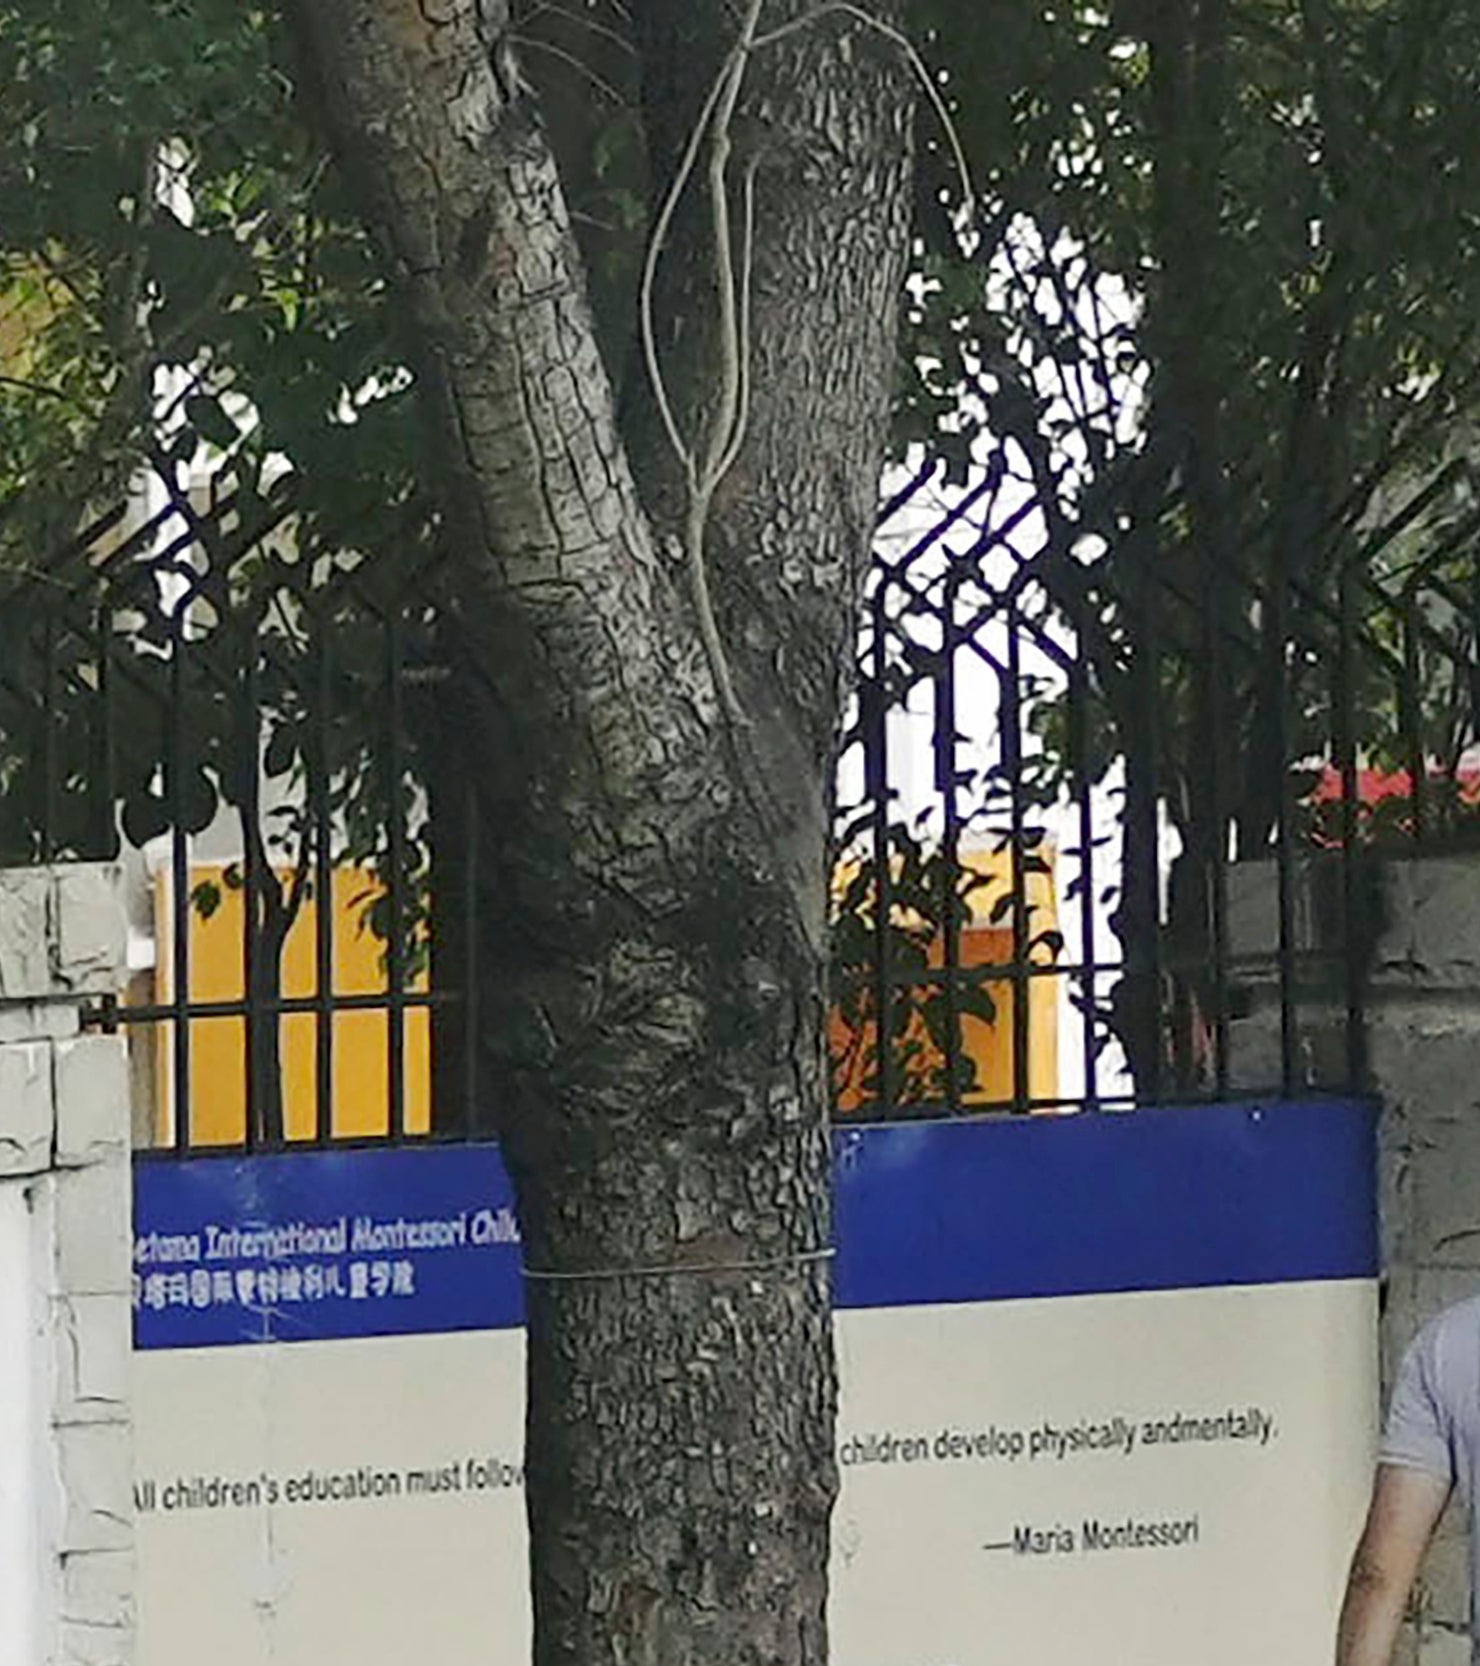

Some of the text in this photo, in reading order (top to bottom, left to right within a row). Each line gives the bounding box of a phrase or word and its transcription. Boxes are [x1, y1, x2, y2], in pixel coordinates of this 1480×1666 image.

[205, 1216, 348, 1261] International
[351, 1213, 466, 1252] Montessori
[840, 1430, 929, 1467] children
[933, 1425, 1024, 1462] develop
[1029, 1415, 1136, 1456] physically
[162, 1472, 280, 1512] children's
[284, 1464, 402, 1504] education
[406, 1462, 462, 1494] must
[1081, 1514, 1200, 1552] Montessori
